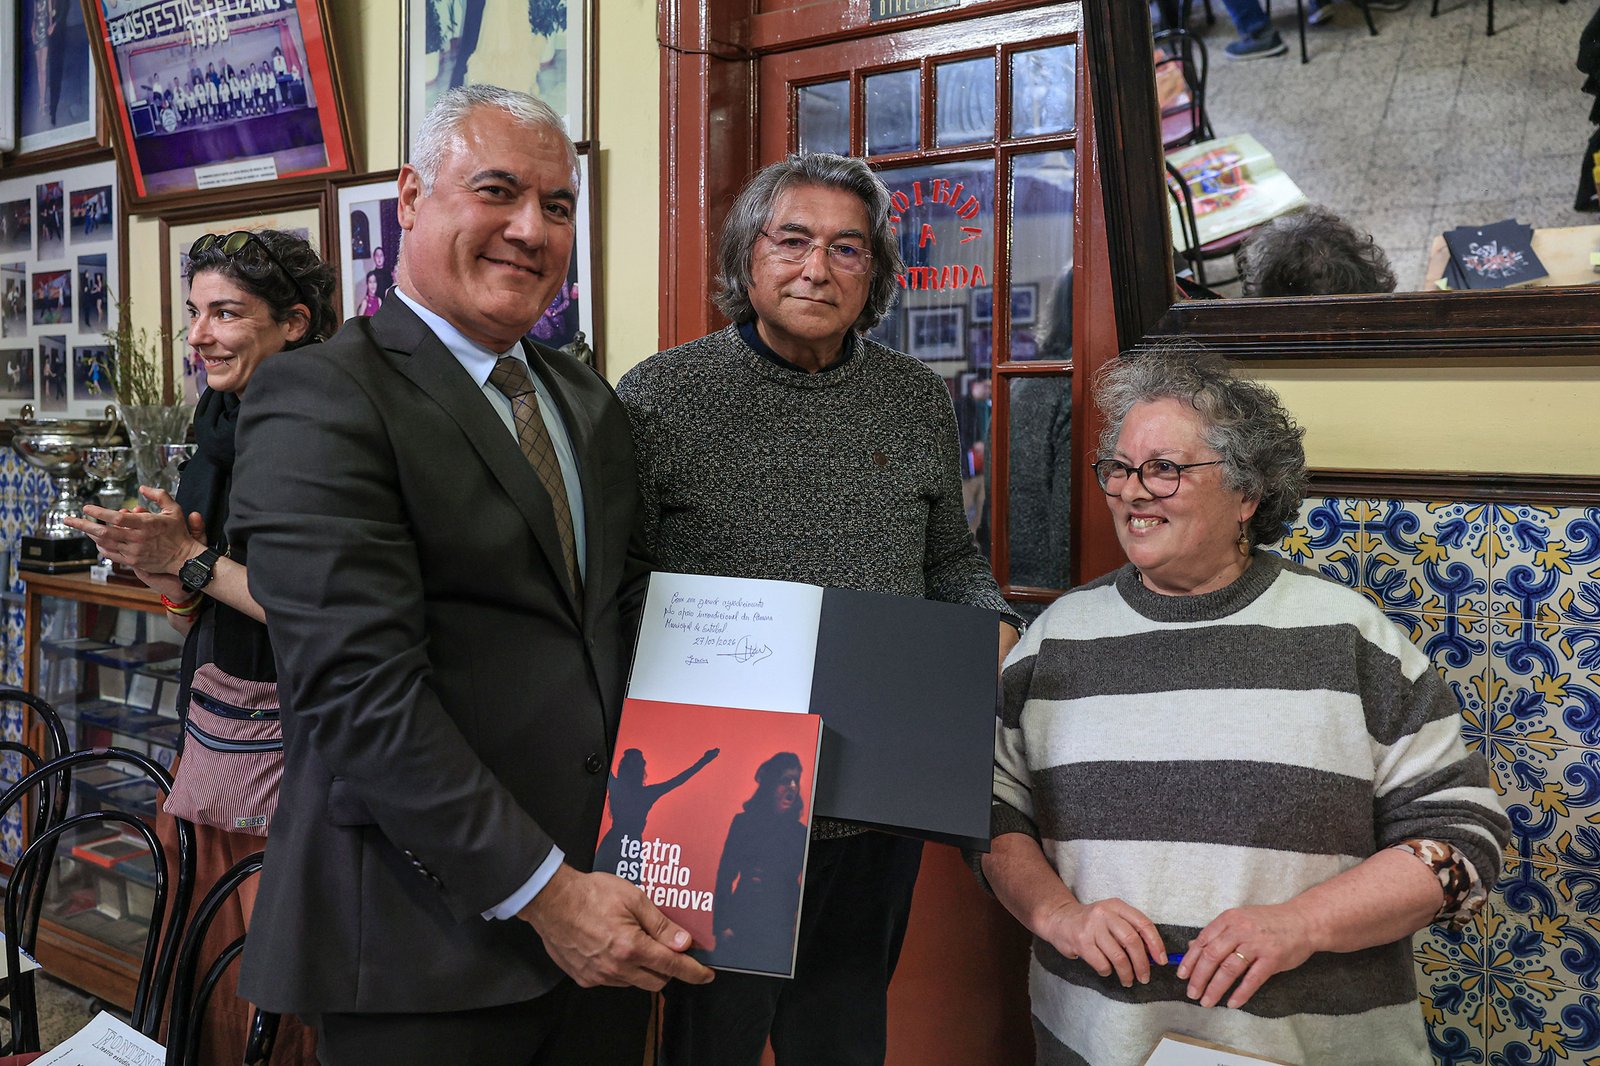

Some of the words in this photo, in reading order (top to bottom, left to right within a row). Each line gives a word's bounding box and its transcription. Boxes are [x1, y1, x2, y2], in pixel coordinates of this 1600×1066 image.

[186, 15, 229, 47] 1988
[890, 178, 982, 244] OIBIDA
[919, 223, 936, 248] A
[620, 834, 682, 863] teatro
